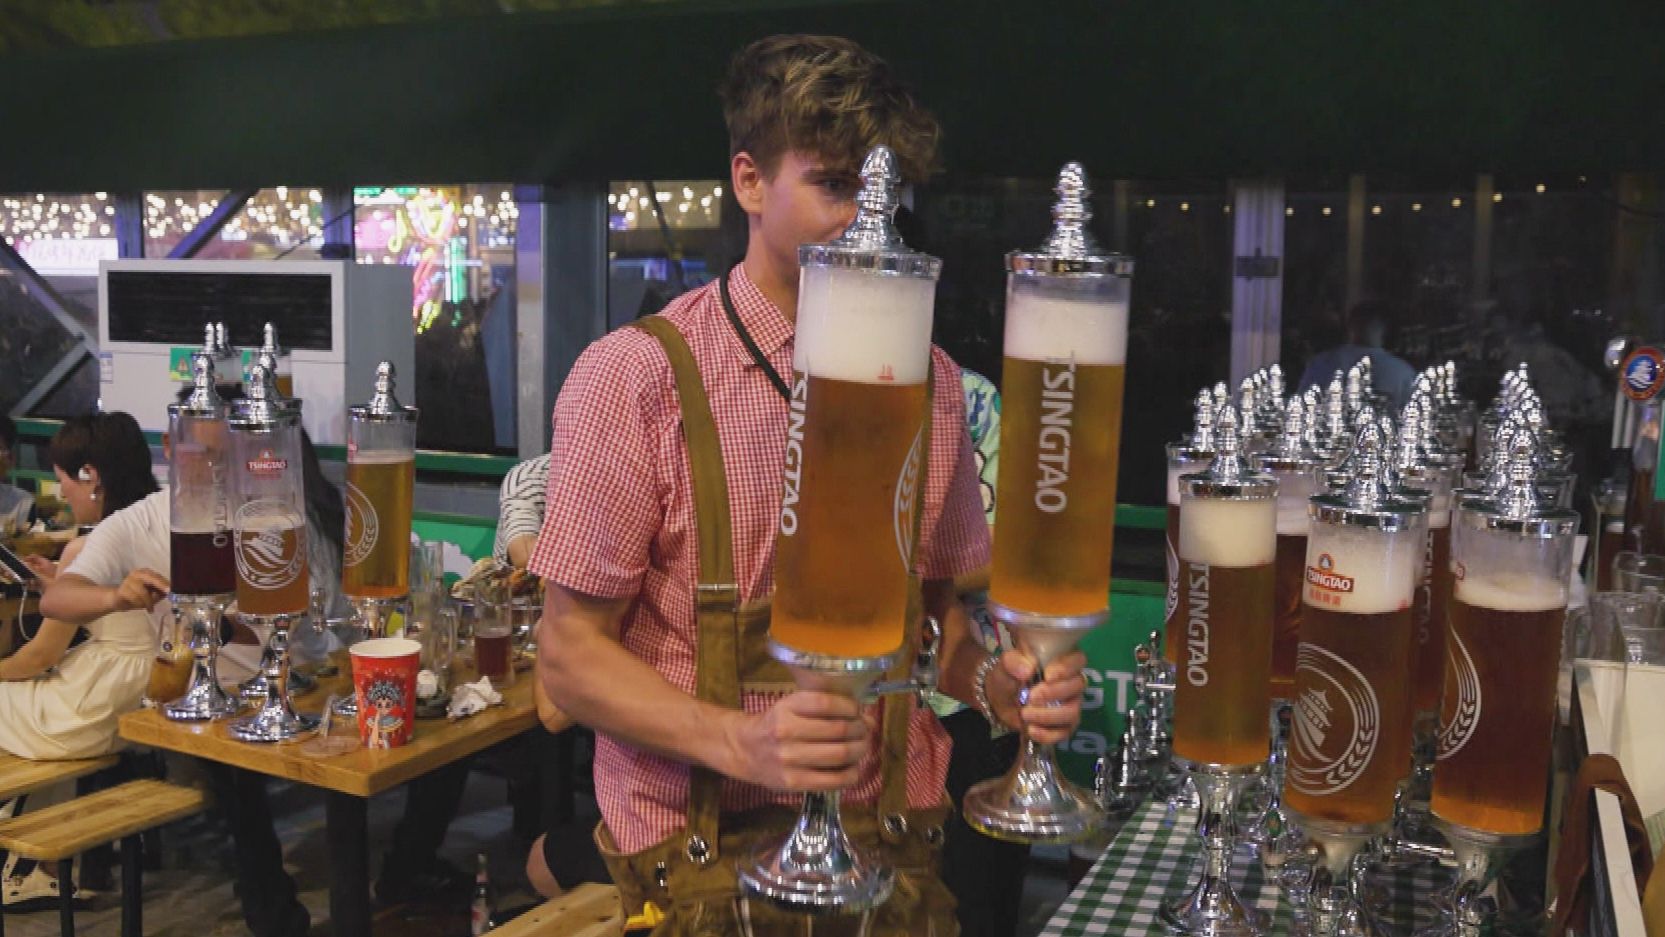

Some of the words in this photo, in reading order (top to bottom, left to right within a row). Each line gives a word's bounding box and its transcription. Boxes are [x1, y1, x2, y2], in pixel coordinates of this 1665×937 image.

[1034, 350, 1075, 513] TSINGTAO
[1186, 562, 1210, 687] TSINGTAO
[1307, 567, 1352, 591] TSINGTAO
